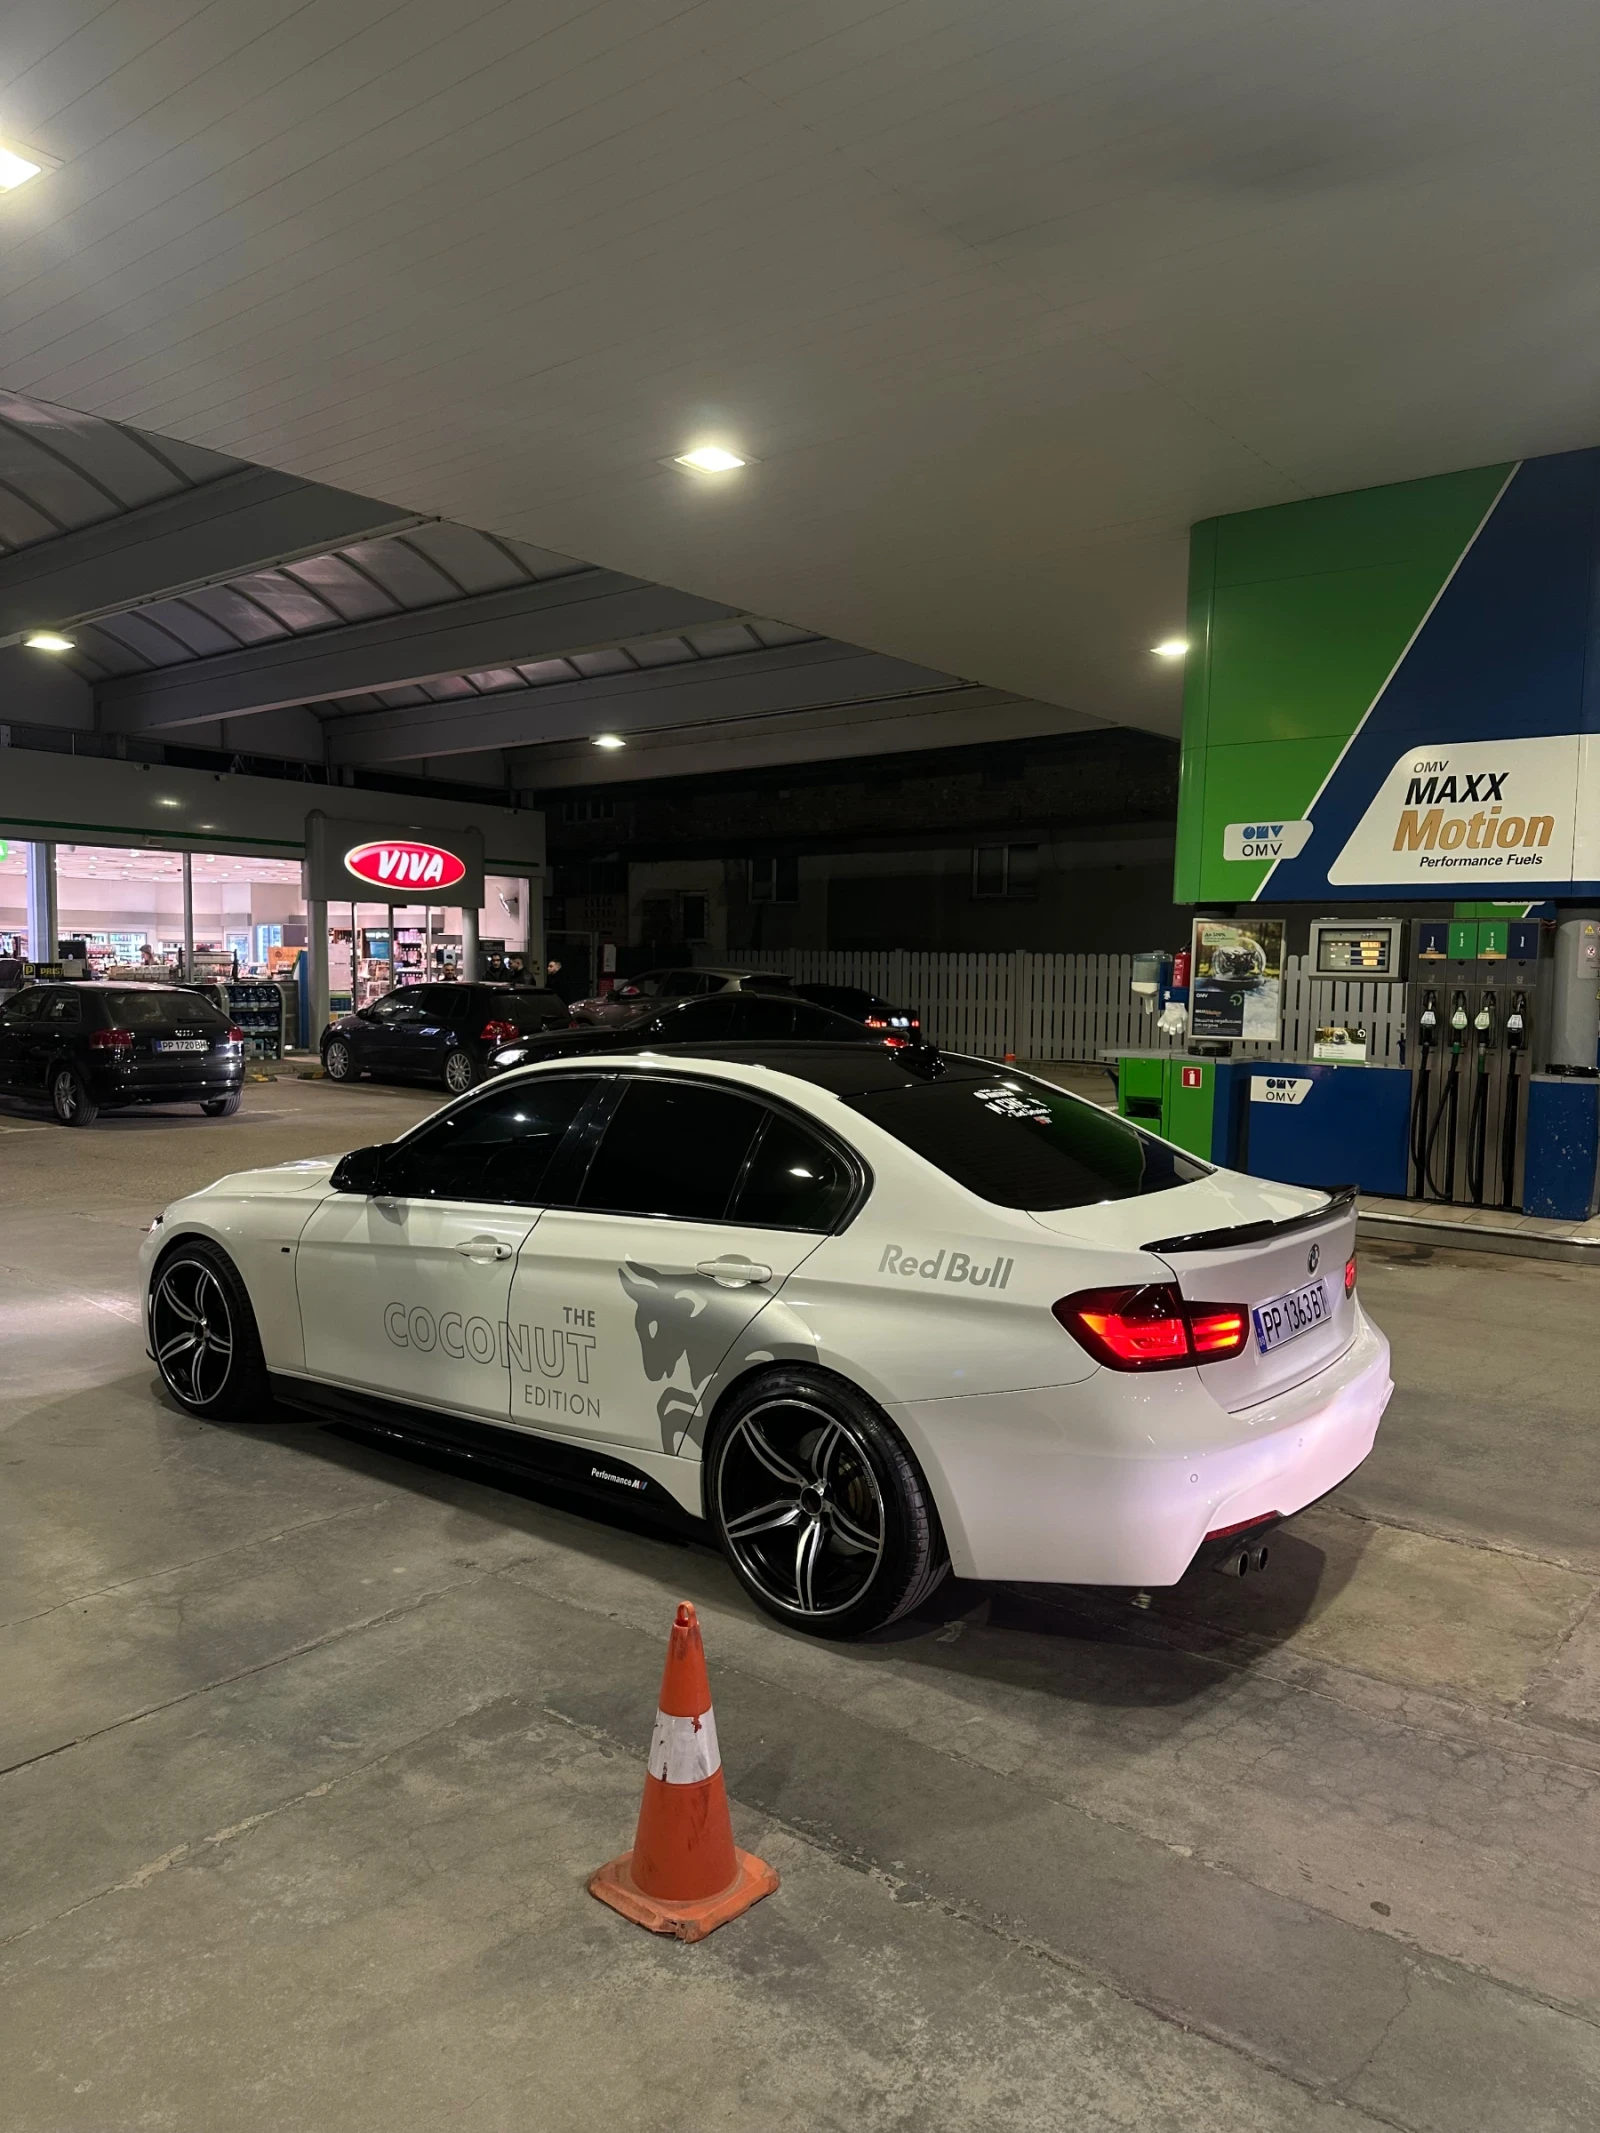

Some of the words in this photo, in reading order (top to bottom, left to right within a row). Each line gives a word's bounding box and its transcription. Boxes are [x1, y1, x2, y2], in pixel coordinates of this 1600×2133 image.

[1413, 760, 1449, 773] OMV
[1405, 772, 1510, 805] MAXX
[1392, 806, 1555, 851] Motion
[1242, 843, 1282, 857] OMV
[1419, 856, 1503, 867] Performance
[1506, 853, 1543, 866] Fuels
[378, 849, 444, 883] VIVA
[1266, 1091, 1296, 1102] OMV
[563, 1307, 595, 1327] THE
[384, 1302, 596, 1384] COCONUT
[525, 1385, 600, 1418] EDITION
[591, 1467, 632, 1486] Performance
